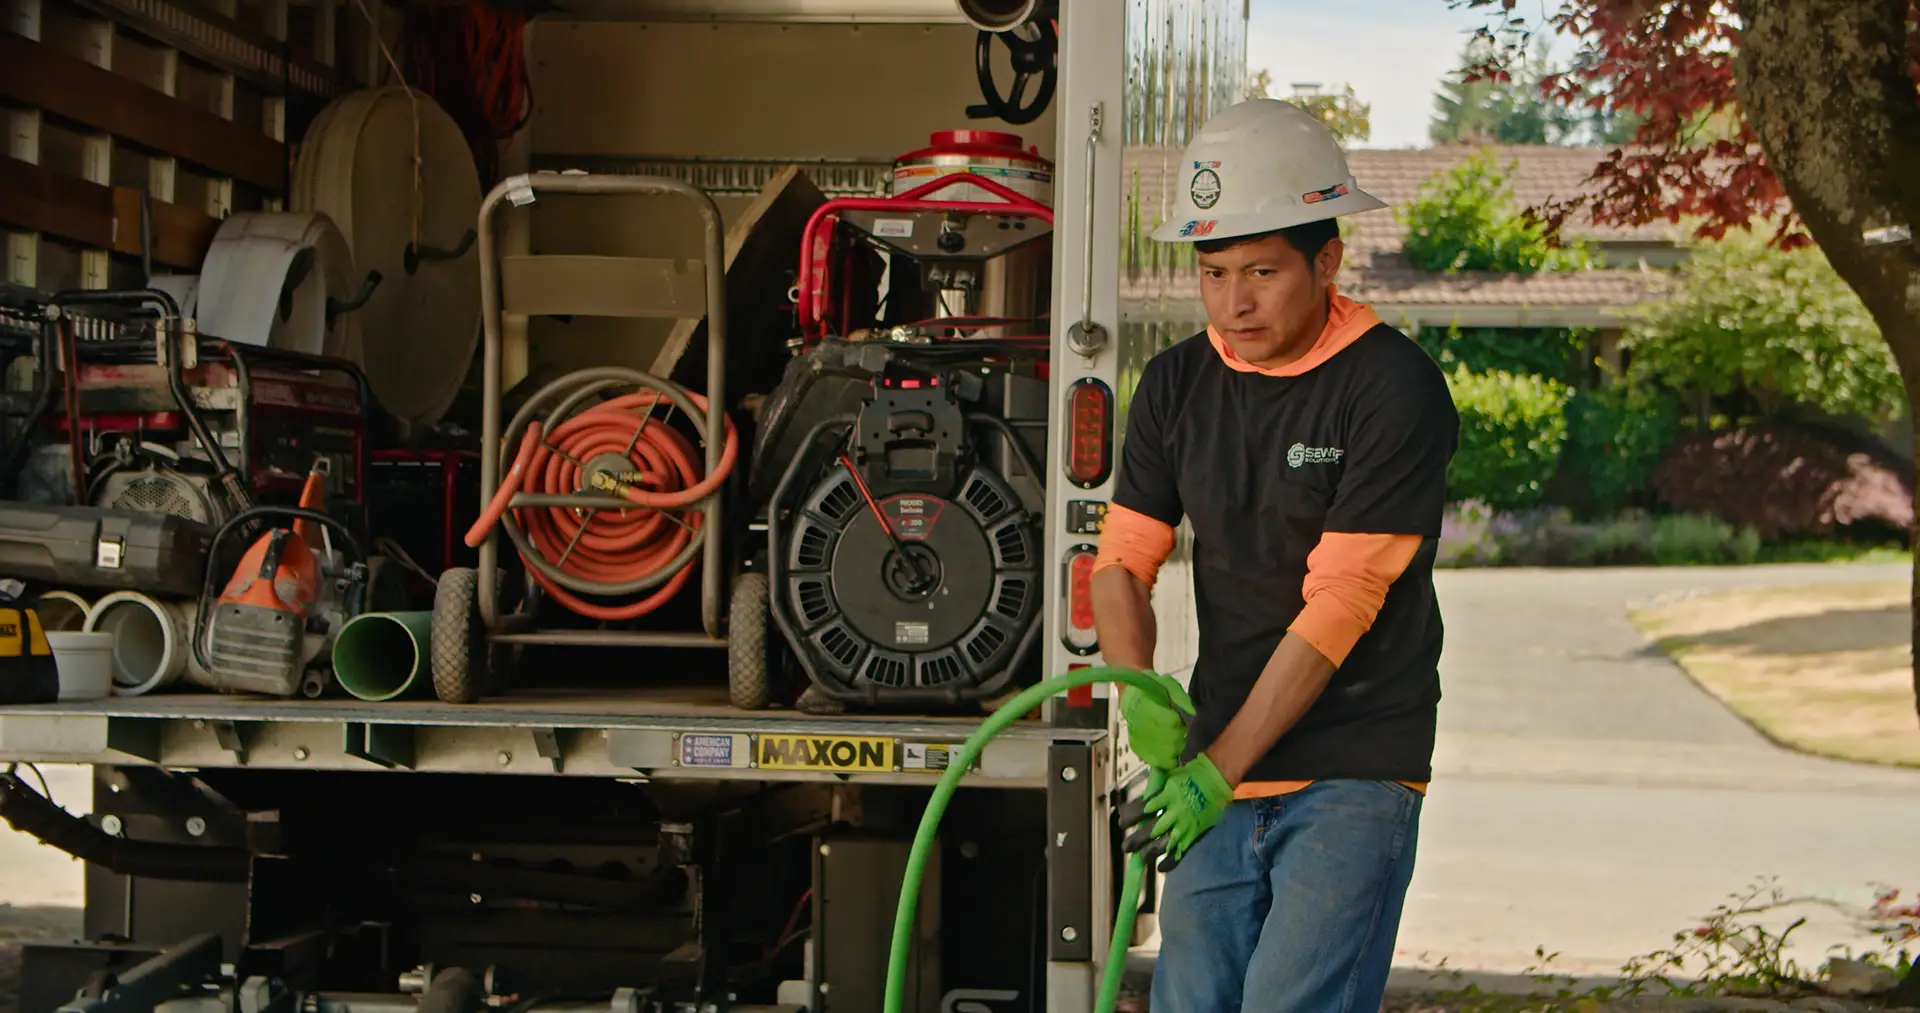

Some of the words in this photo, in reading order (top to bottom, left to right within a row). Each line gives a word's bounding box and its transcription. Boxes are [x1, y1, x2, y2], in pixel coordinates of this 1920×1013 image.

[694, 737, 730, 746] AMERICAN
[693, 747, 730, 757] COMPANY
[762, 739, 884, 766] MAXON
